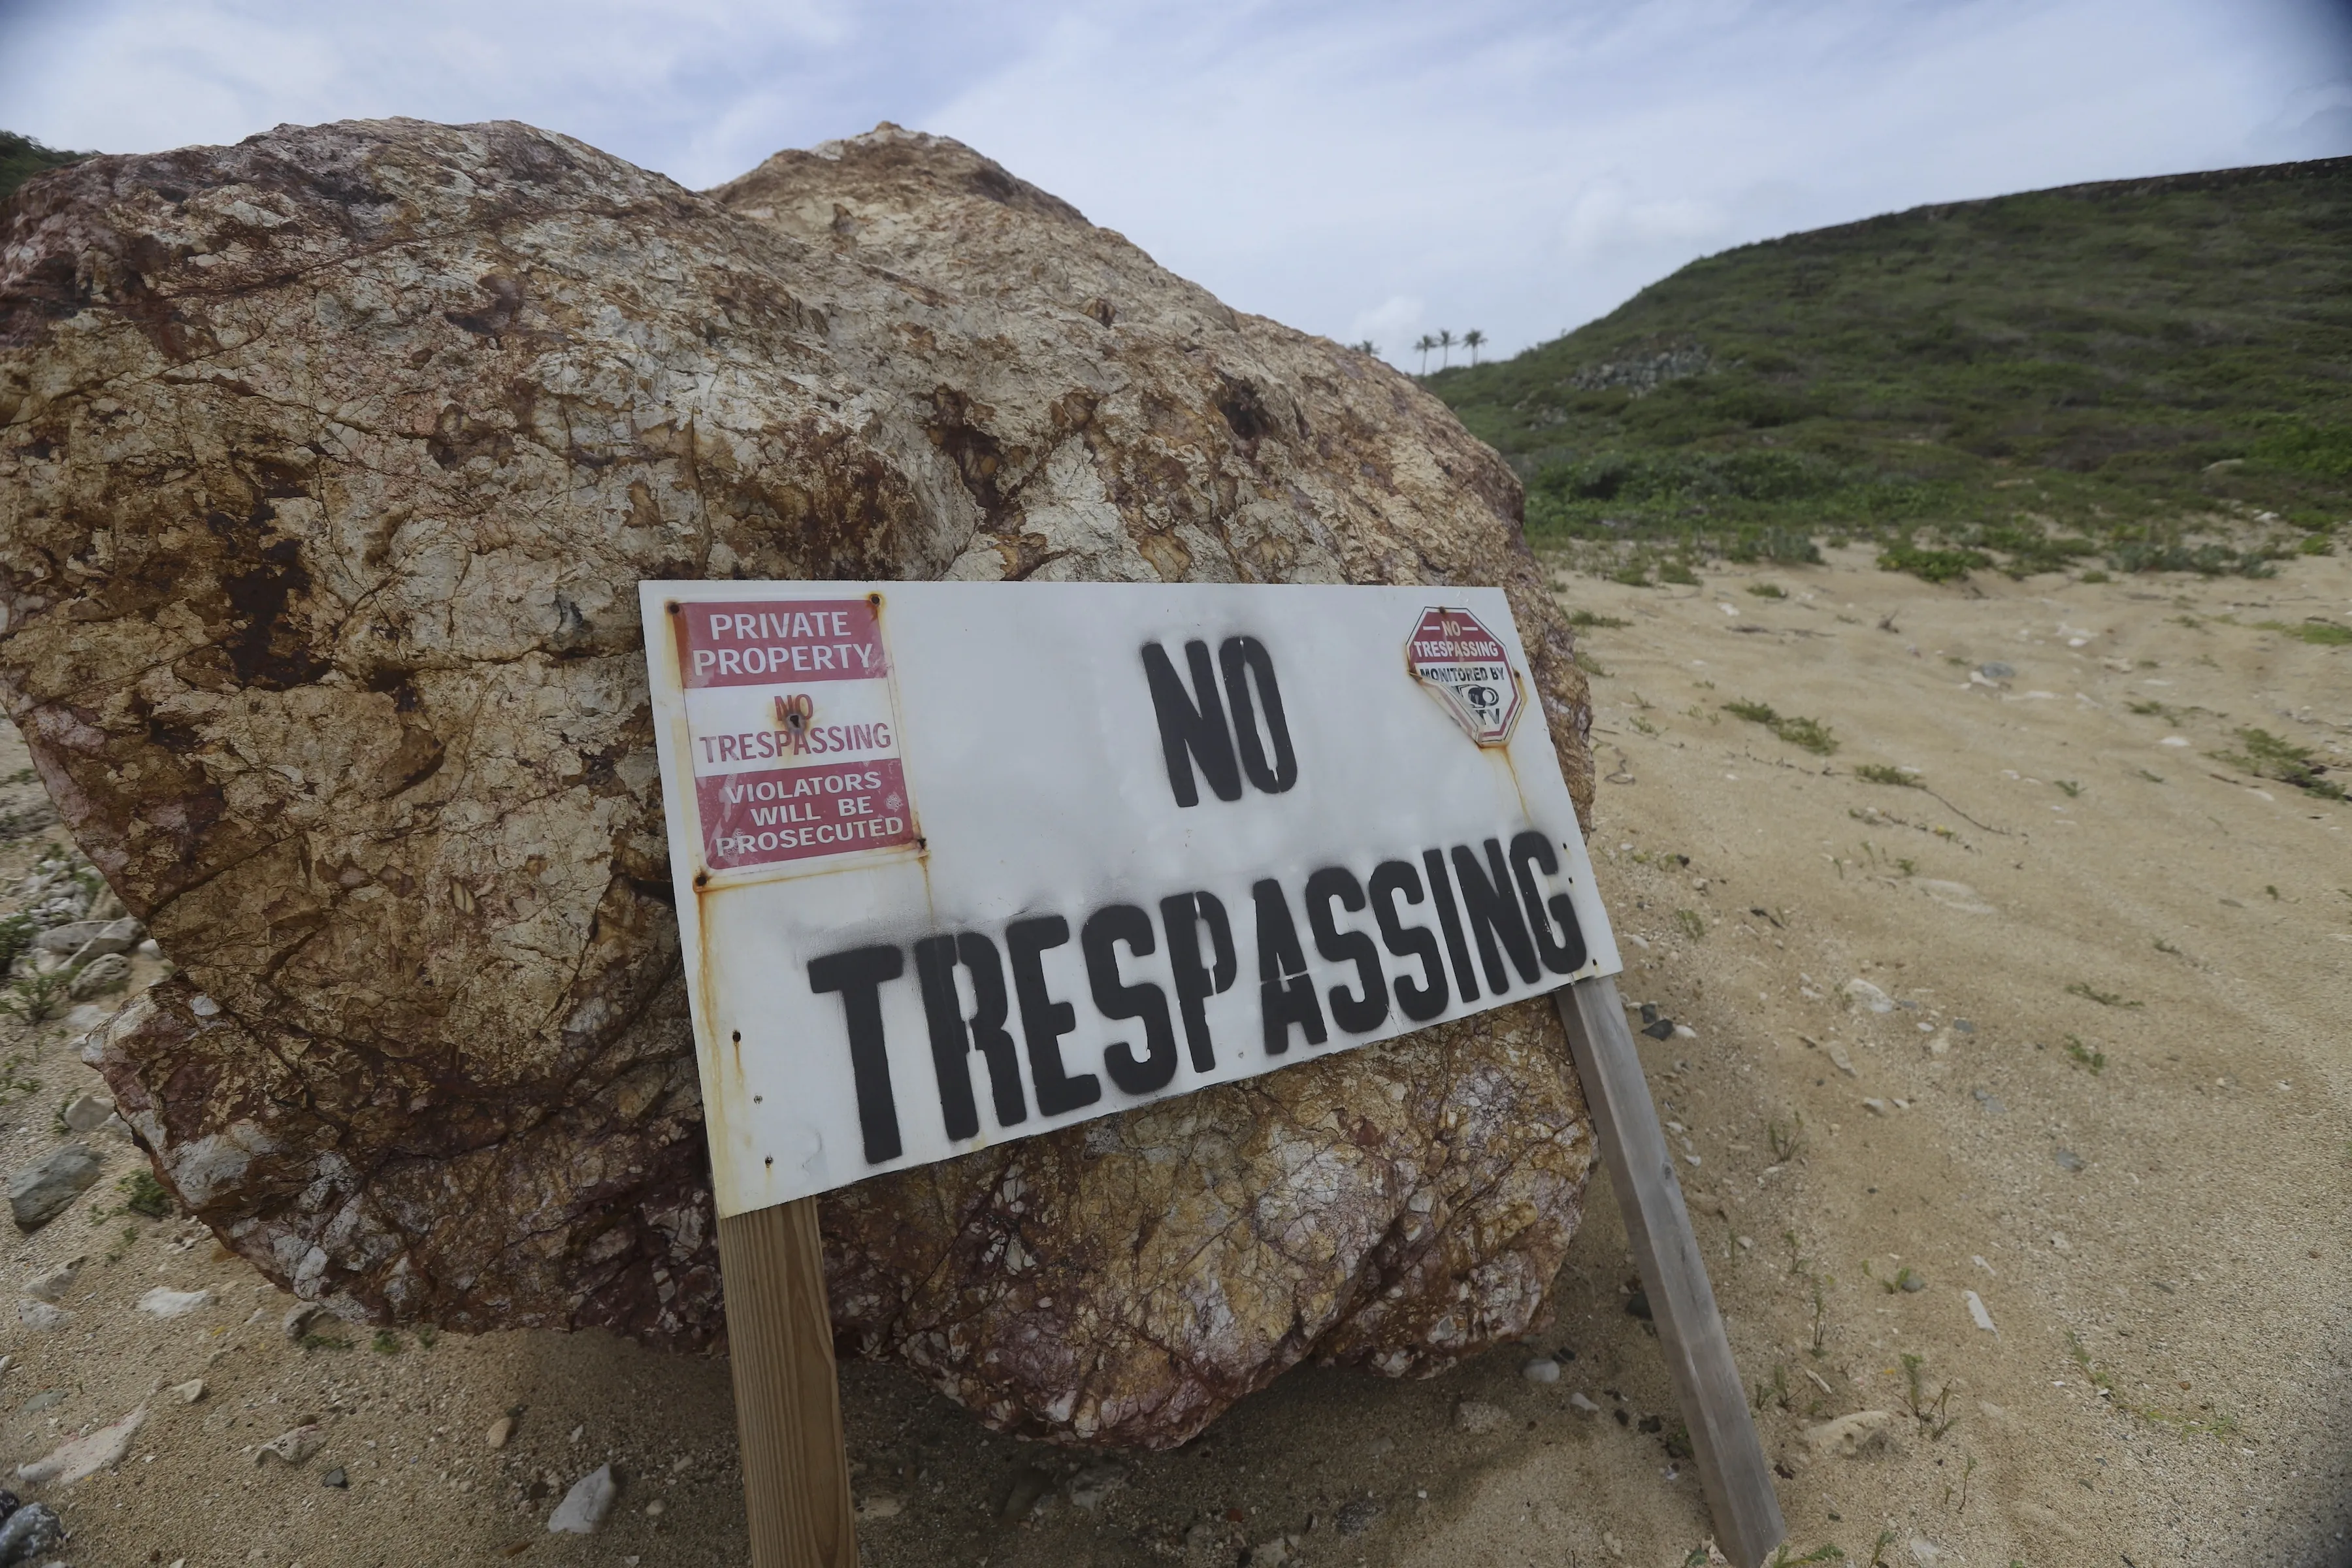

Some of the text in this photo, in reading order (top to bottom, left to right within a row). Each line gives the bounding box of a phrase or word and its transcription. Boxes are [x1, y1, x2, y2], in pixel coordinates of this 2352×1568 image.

[710, 611, 851, 640] PRIVATE
[1441, 621, 1461, 636] NO
[692, 643, 873, 676] PROPERTY
[1414, 641, 1498, 657] TRESPASSING
[1420, 667, 1505, 681] MONITORED BY
[774, 693, 813, 721] NO
[1140, 634, 1298, 808] NO
[699, 723, 891, 763] TRESPASSING
[725, 771, 882, 804] VIOLATORS
[750, 796, 874, 826] WILL BE
[715, 817, 903, 857] PROSECUTED
[807, 830, 1587, 1164] TRESPASSING
